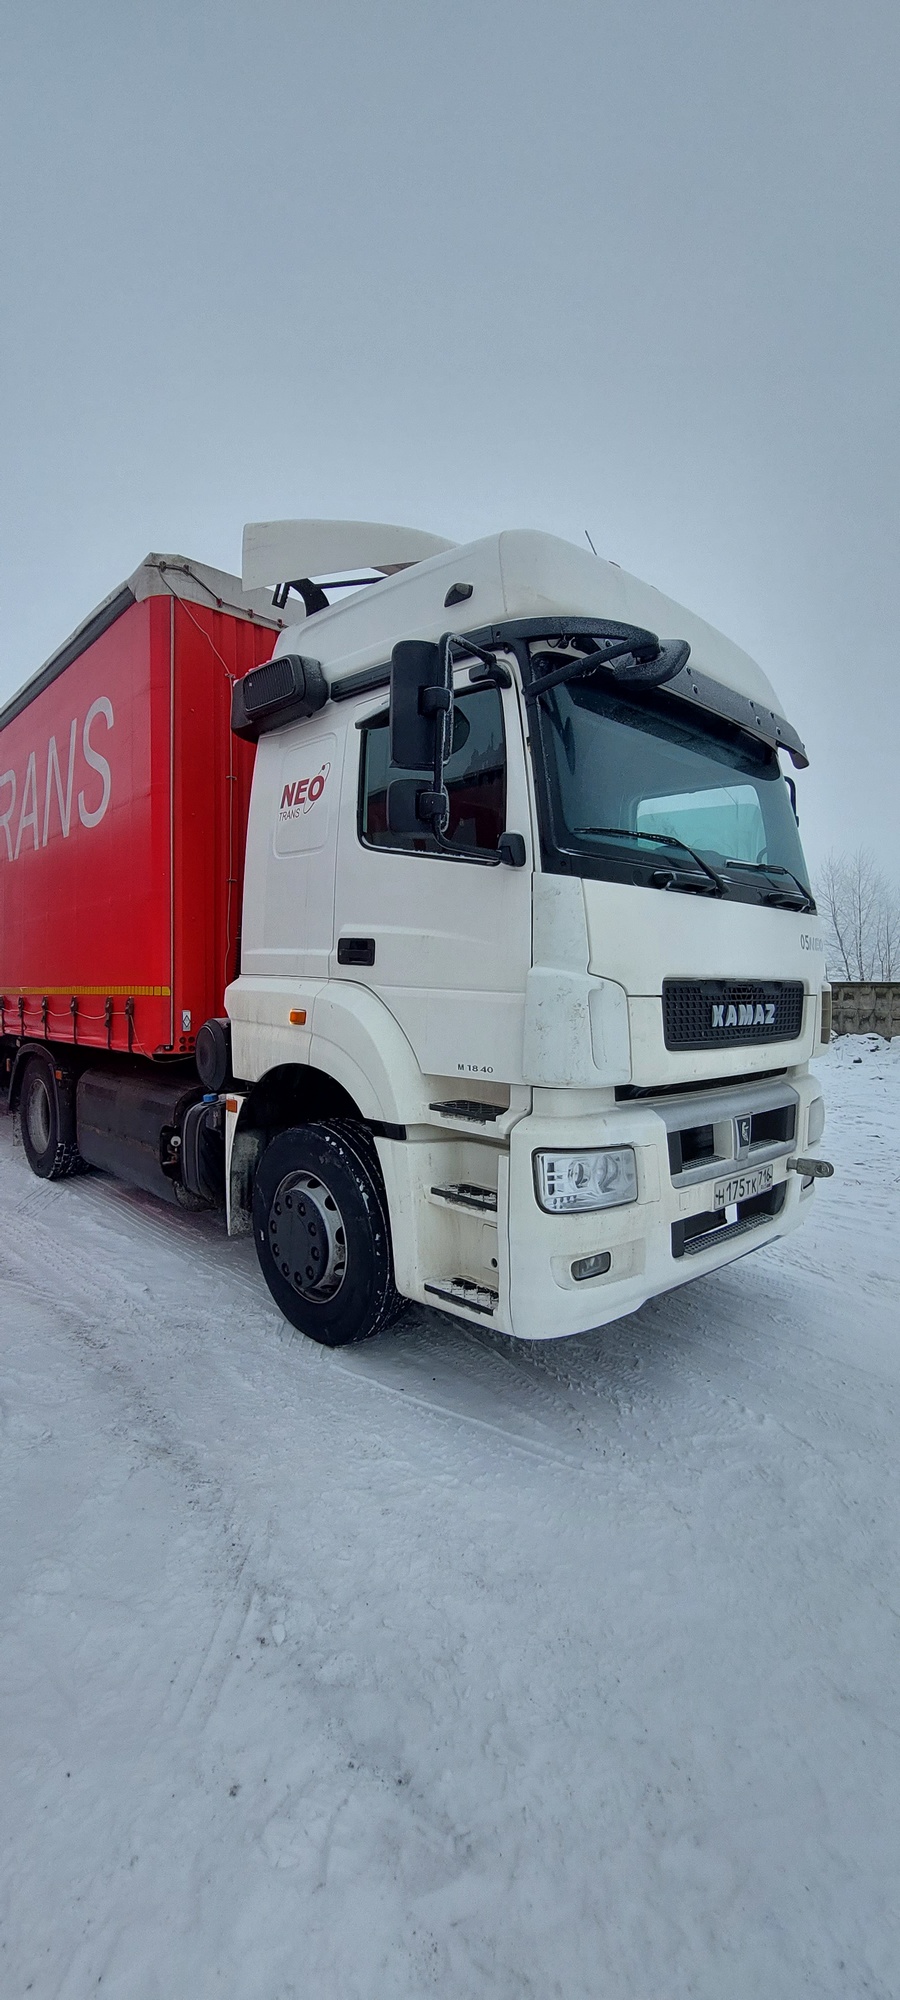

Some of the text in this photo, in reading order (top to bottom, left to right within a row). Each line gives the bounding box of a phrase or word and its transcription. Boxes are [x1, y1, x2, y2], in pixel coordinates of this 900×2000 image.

[0, 696, 114, 862] RANS
[280, 775, 325, 809] NEO
[279, 808, 301, 821] TRANS
[712, 1003, 775, 1027] KAMAZ
[457, 1063, 465, 1071] M
